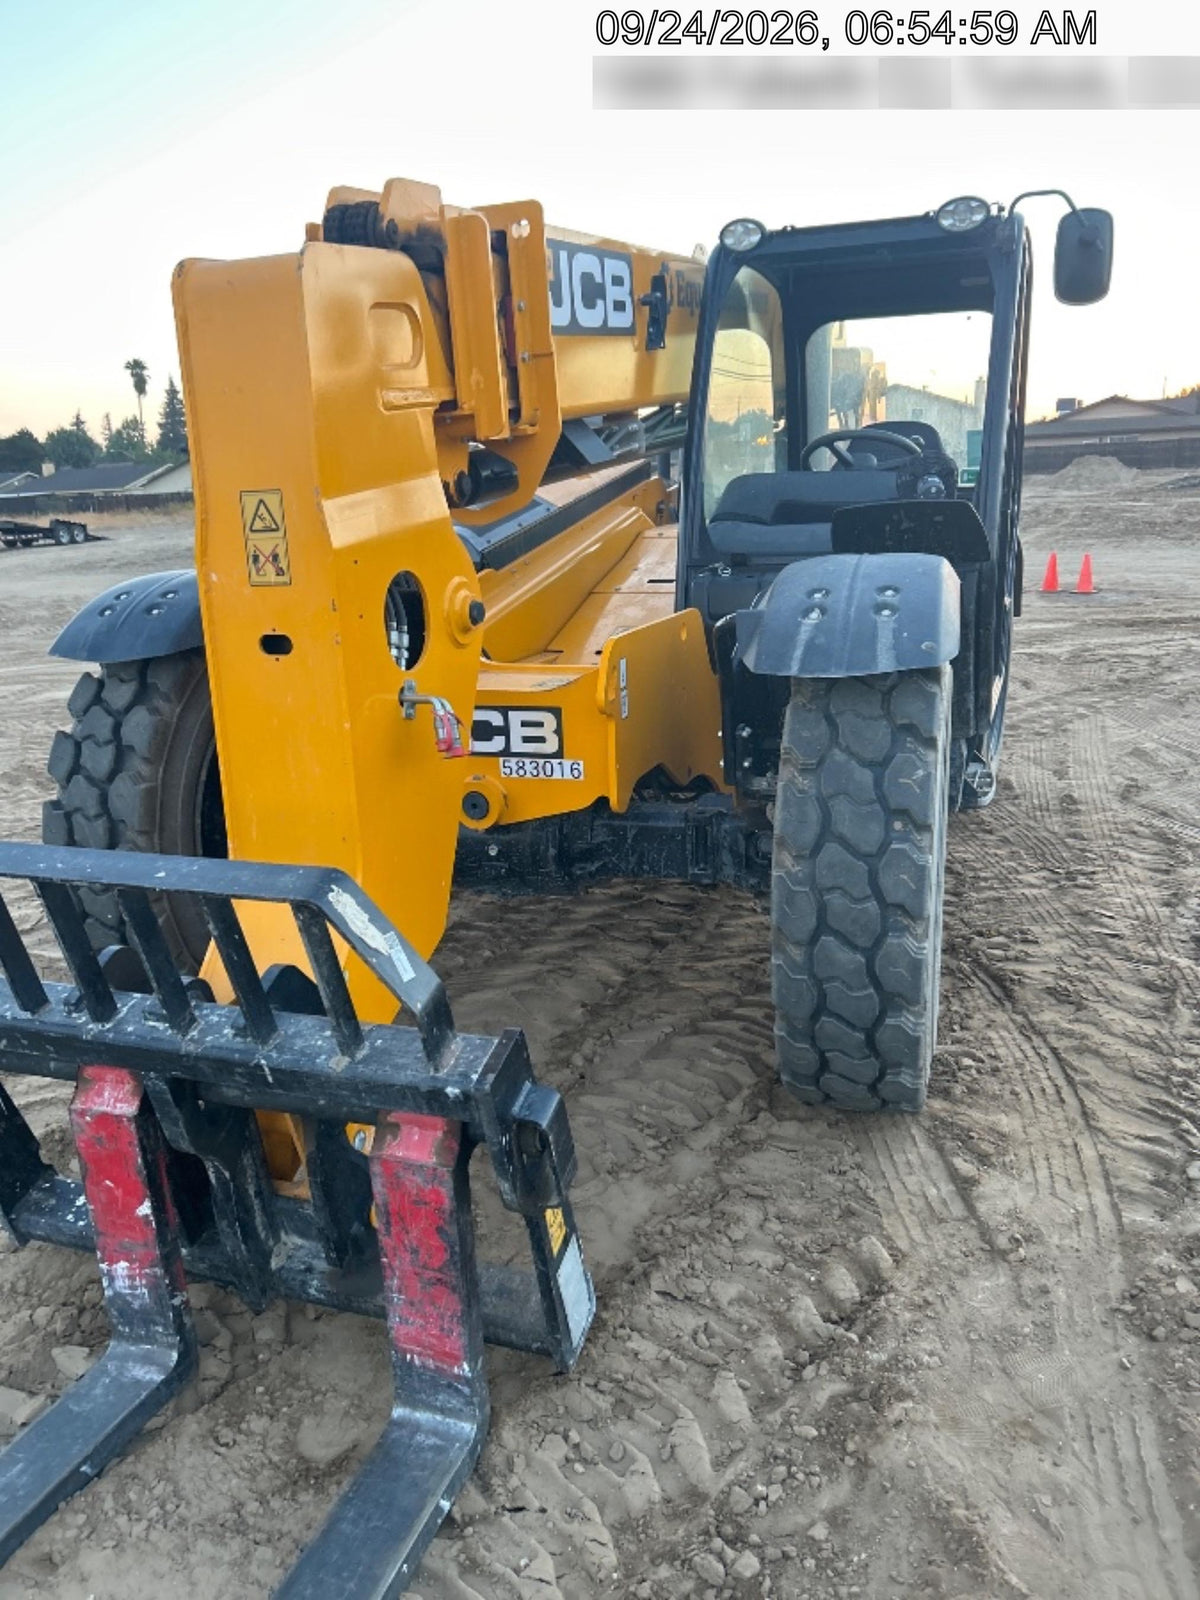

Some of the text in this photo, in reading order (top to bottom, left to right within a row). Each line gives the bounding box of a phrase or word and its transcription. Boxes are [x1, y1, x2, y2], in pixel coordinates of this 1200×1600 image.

[548, 250, 634, 327] JCB
[470, 709, 559, 754] CB
[501, 760, 582, 779] 583016
